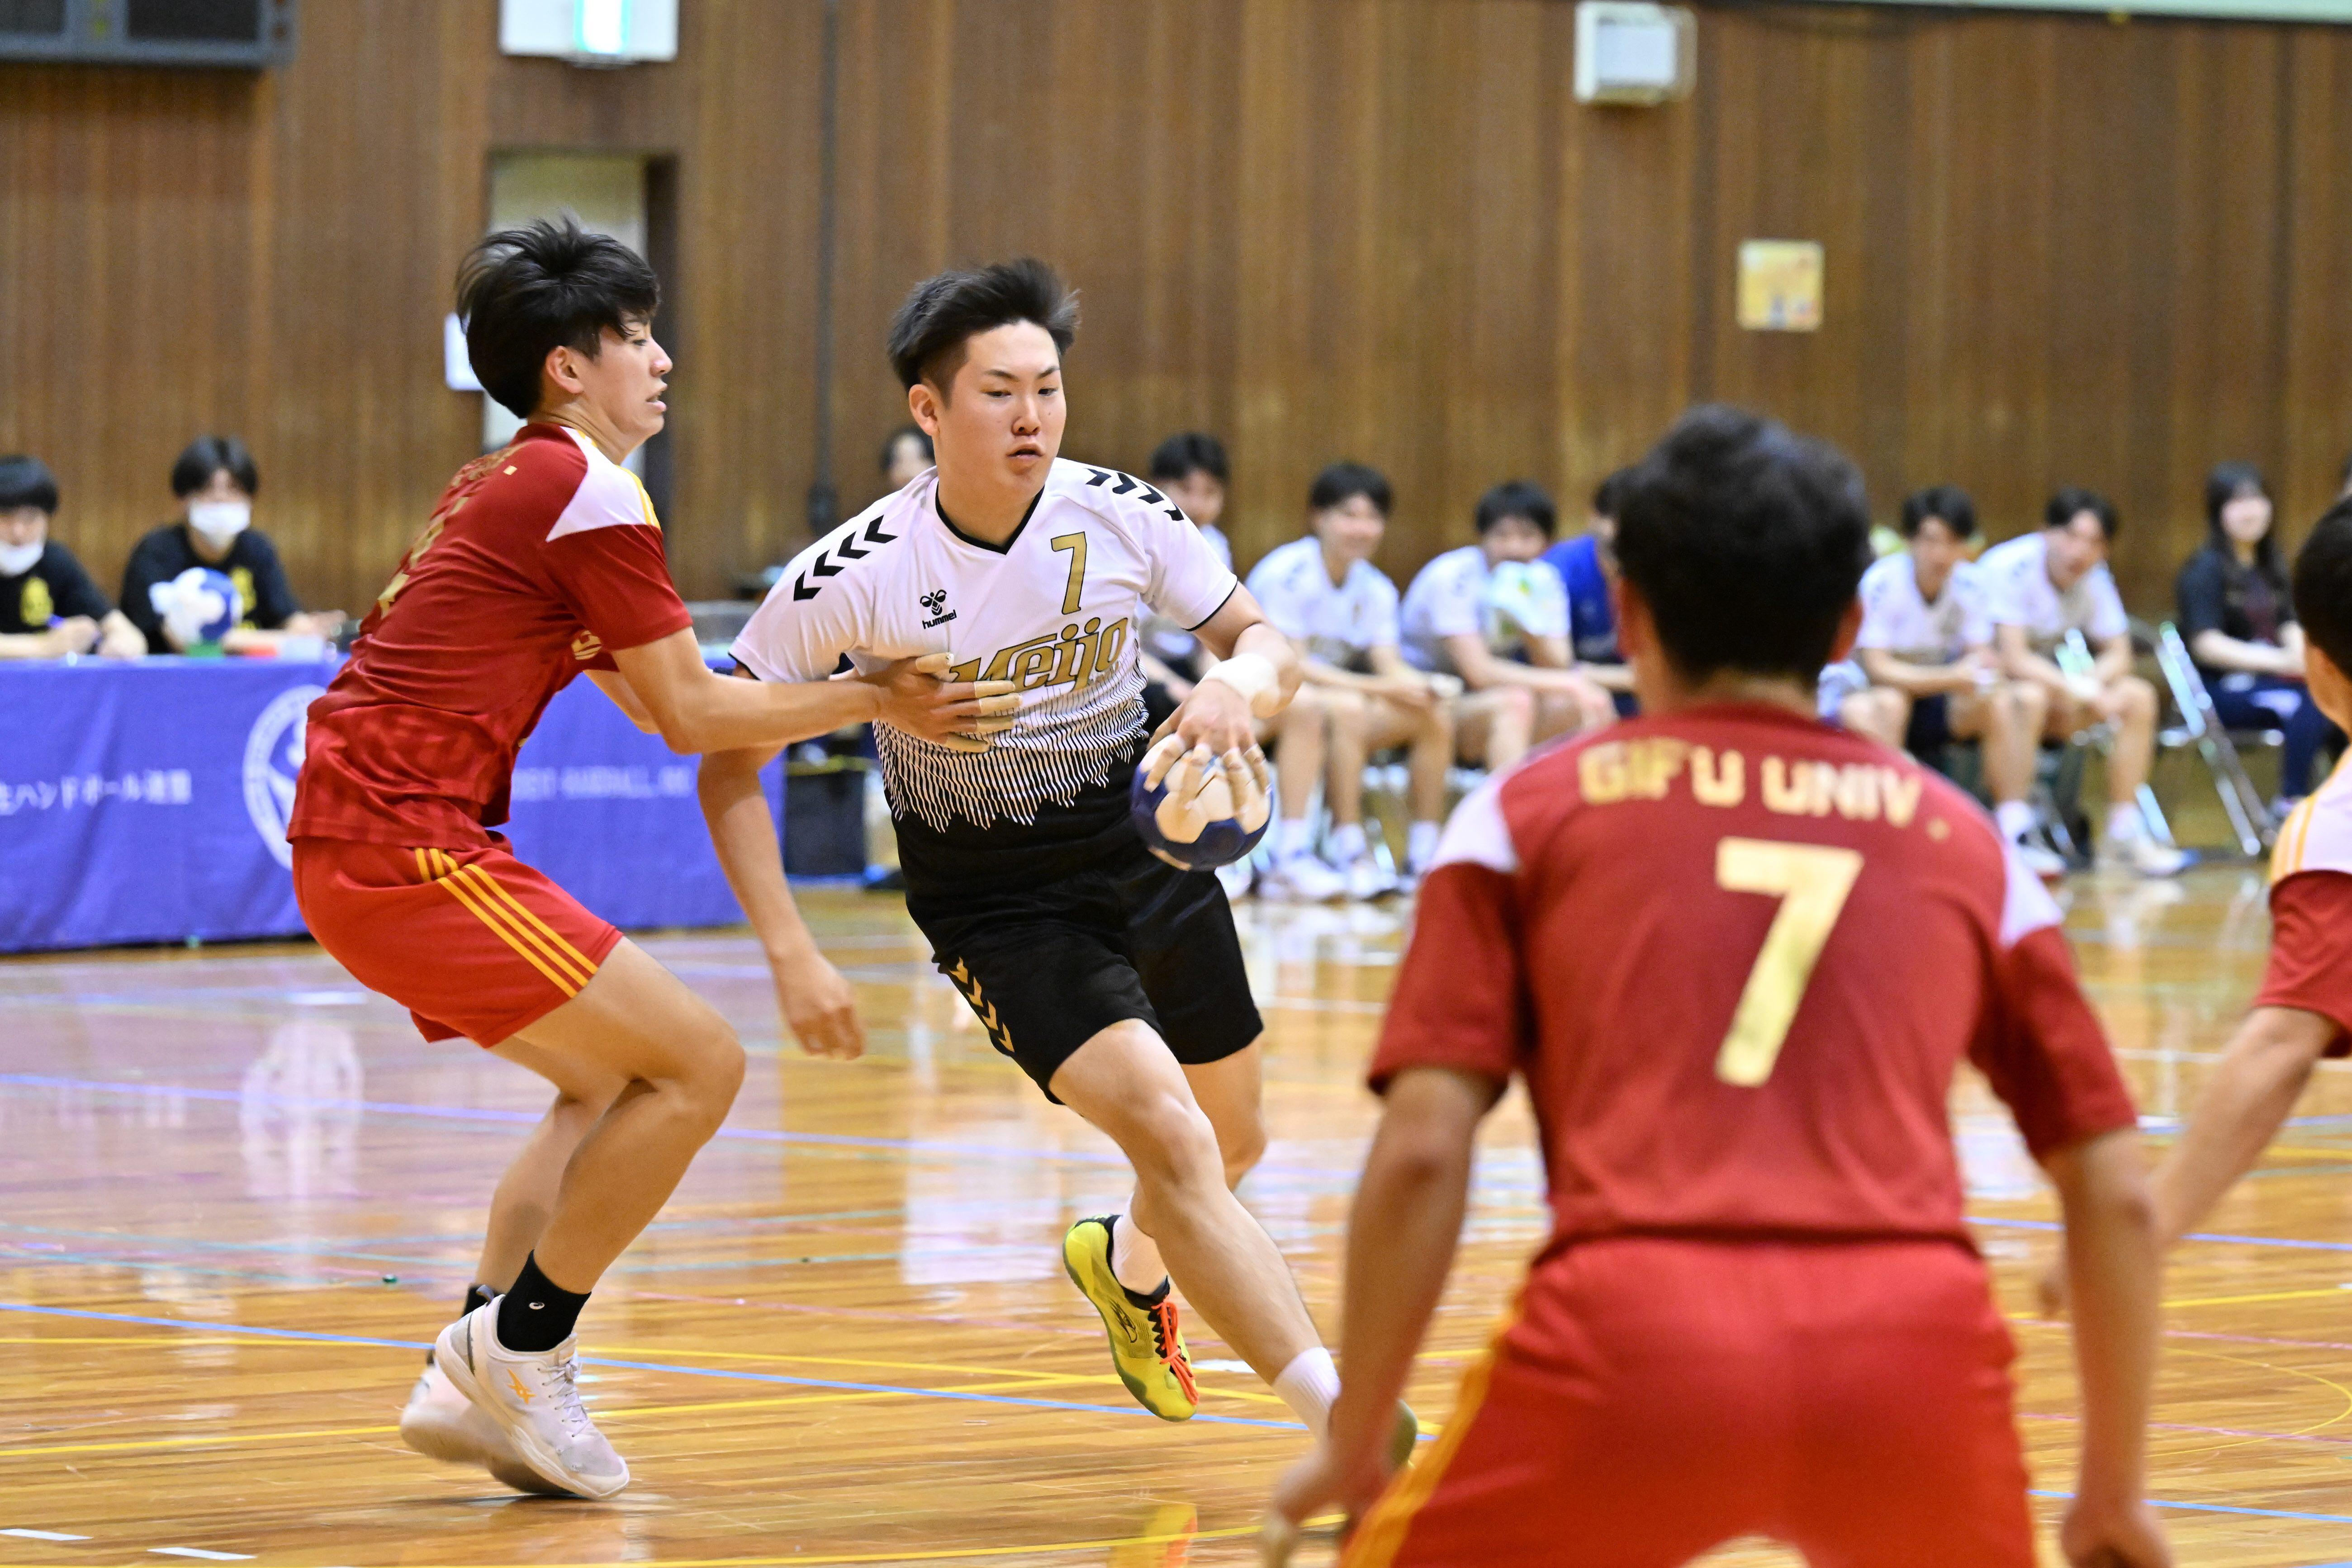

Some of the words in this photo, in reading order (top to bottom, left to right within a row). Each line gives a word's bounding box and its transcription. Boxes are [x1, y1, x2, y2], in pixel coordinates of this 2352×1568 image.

[1051, 531, 1087, 615] 7
[922, 609, 957, 630] hummel
[1578, 736, 1747, 809] GIFU
[1714, 836, 1865, 1088] 7
